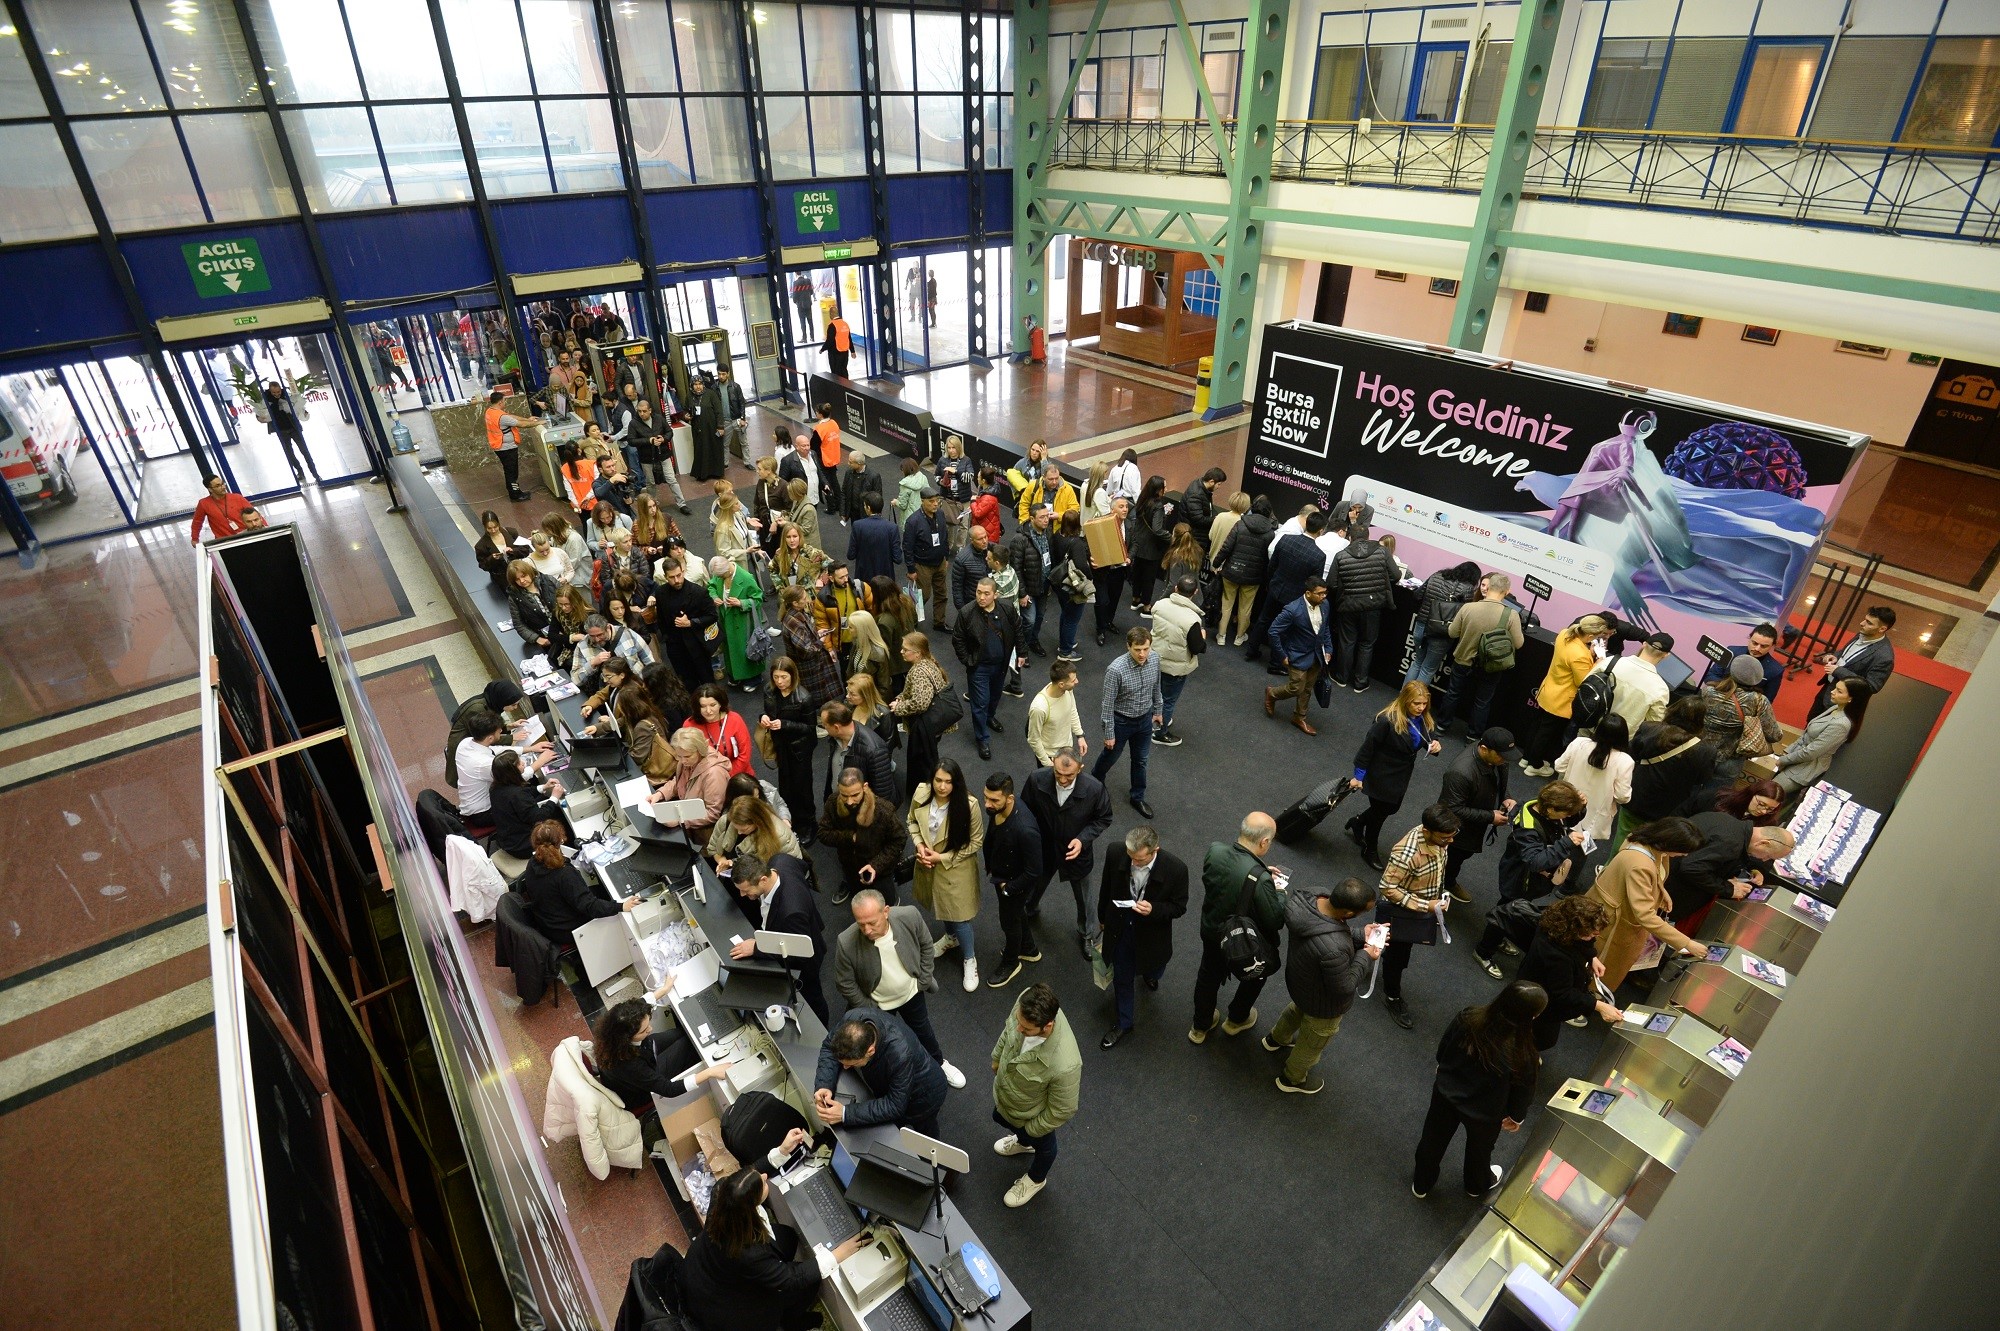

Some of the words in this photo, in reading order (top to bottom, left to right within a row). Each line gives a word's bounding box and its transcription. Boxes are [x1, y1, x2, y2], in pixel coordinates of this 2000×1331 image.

[801, 204, 833, 217] ÇIKIŞ
[198, 256, 256, 276] ÇIKIŞ
[1266, 383, 1314, 410] Bursa
[1265, 401, 1321, 430] Textile
[1355, 371, 1415, 418] Hoş
[1428, 389, 1573, 451] Geldiniz
[1261, 417, 1309, 444] Show
[1361, 408, 1536, 478] Welcome
[1252, 466, 1329, 498] bursatextileshow.com
[1292, 467, 1332, 487] burtexshow
[1468, 525, 1491, 537] BTSO
[1525, 582, 1549, 598] EXHIBITOR
[1704, 647, 1722, 661] PRESS
[1707, 642, 1725, 655] BASIN
